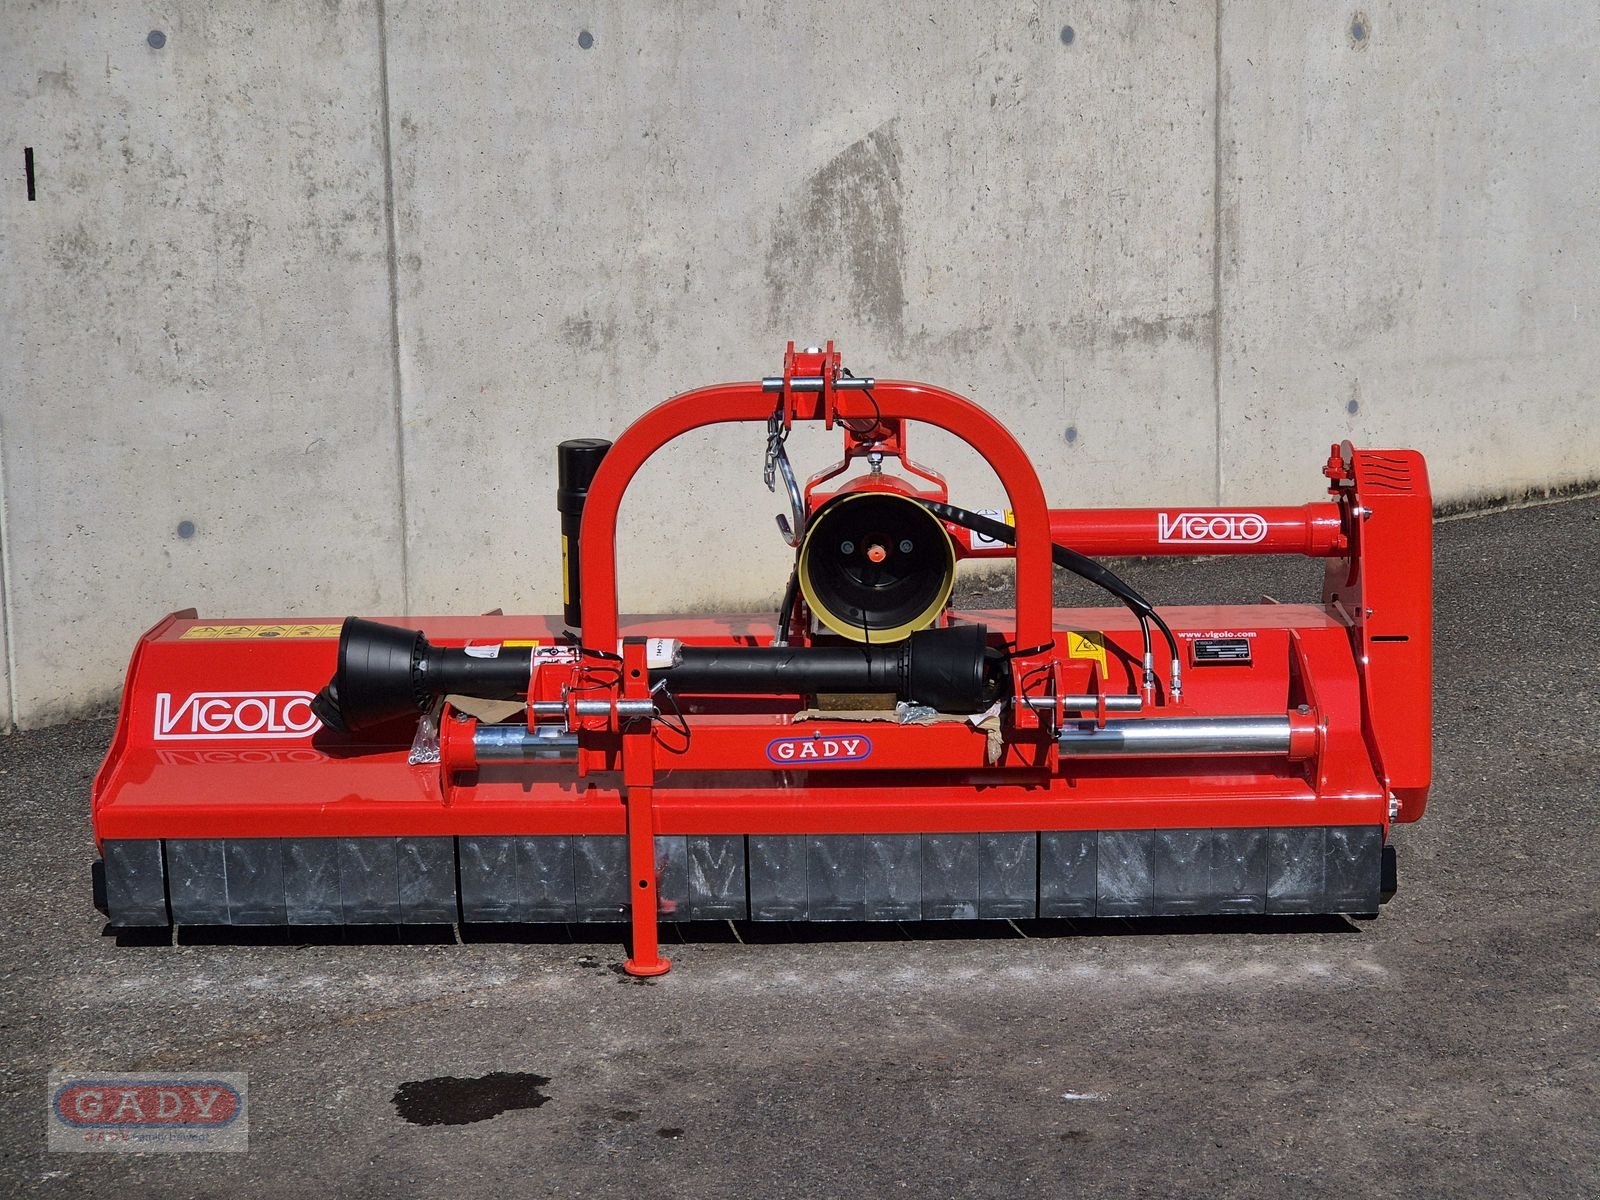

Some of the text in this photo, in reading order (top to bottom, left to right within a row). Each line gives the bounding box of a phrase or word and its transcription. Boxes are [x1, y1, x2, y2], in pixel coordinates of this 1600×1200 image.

[1157, 512, 1268, 545] VIGOLO
[1177, 630, 1257, 639] www.vigolo.com
[154, 690, 323, 740] VIGOLO
[777, 739, 860, 760] GADY
